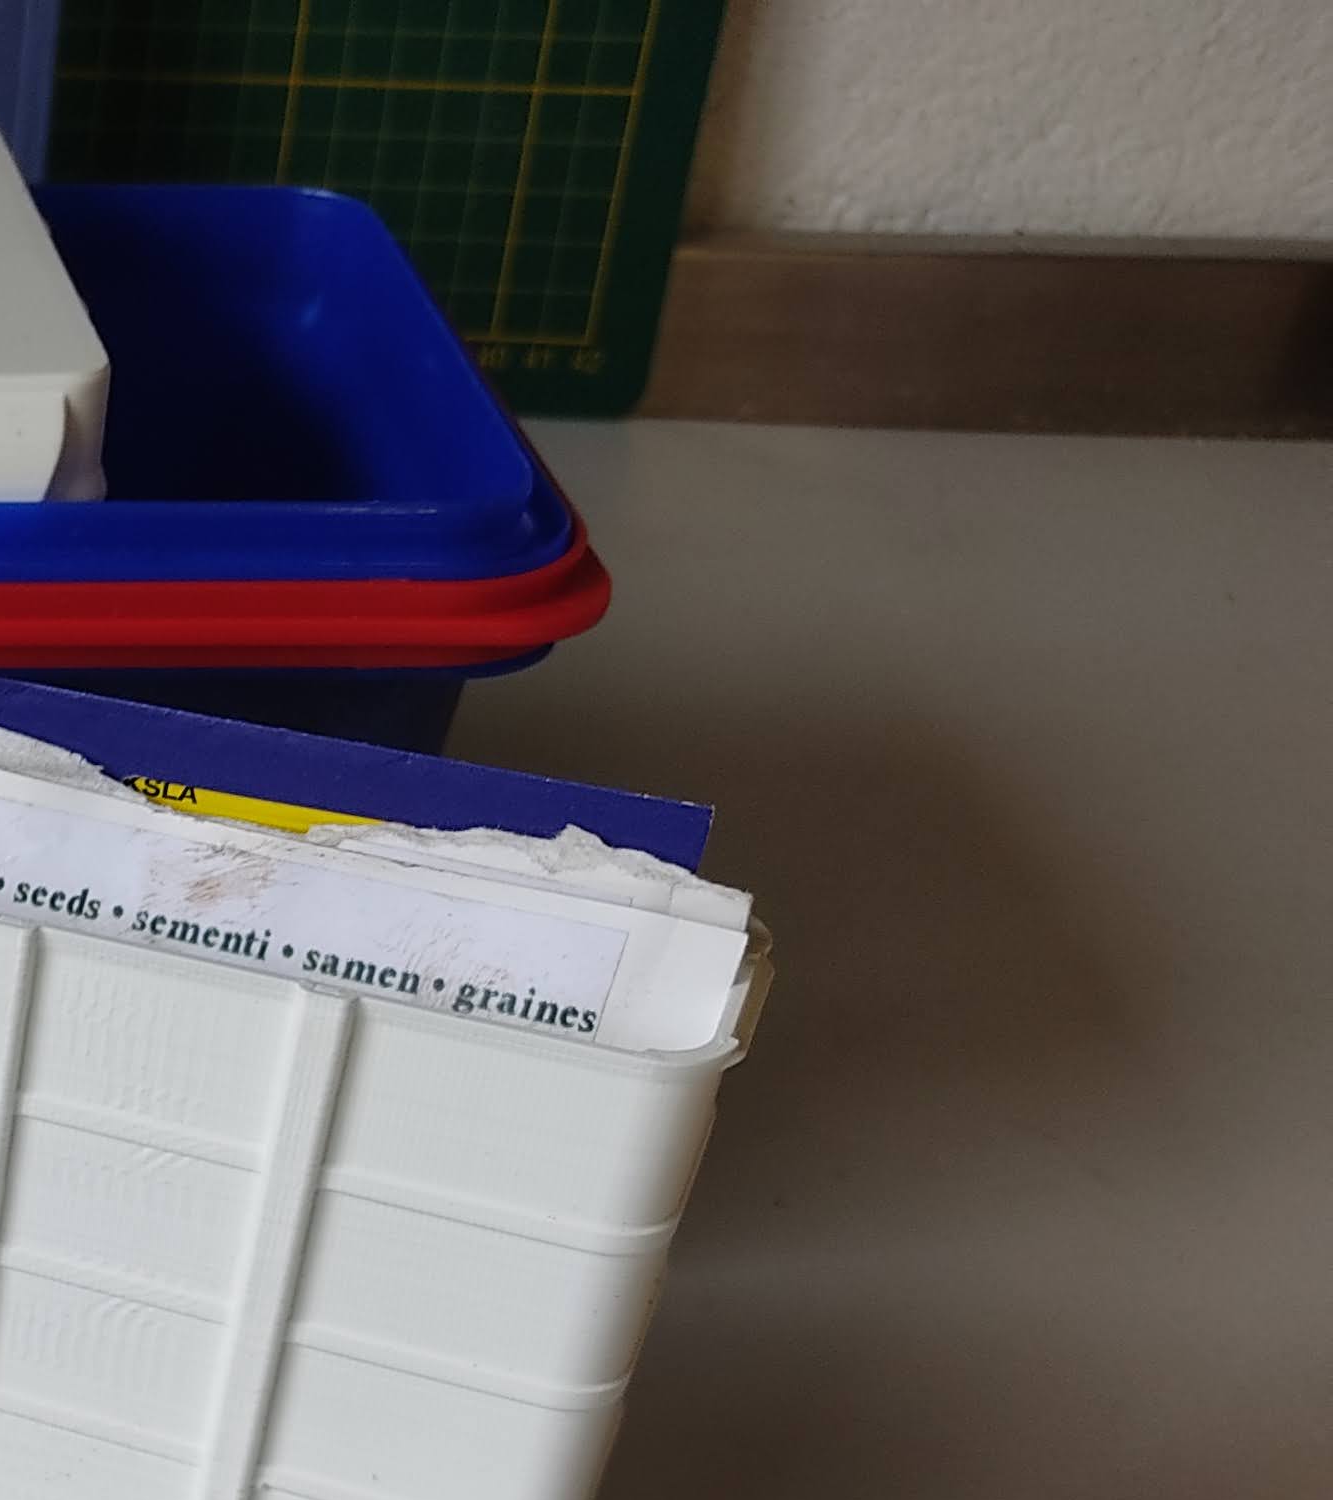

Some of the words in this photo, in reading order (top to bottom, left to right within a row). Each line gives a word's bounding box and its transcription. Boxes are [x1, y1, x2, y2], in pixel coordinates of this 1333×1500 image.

[13, 881, 101, 921] seeds
[131, 909, 272, 961] sementi
[301, 947, 421, 996] samen
[451, 980, 598, 1034] graines
